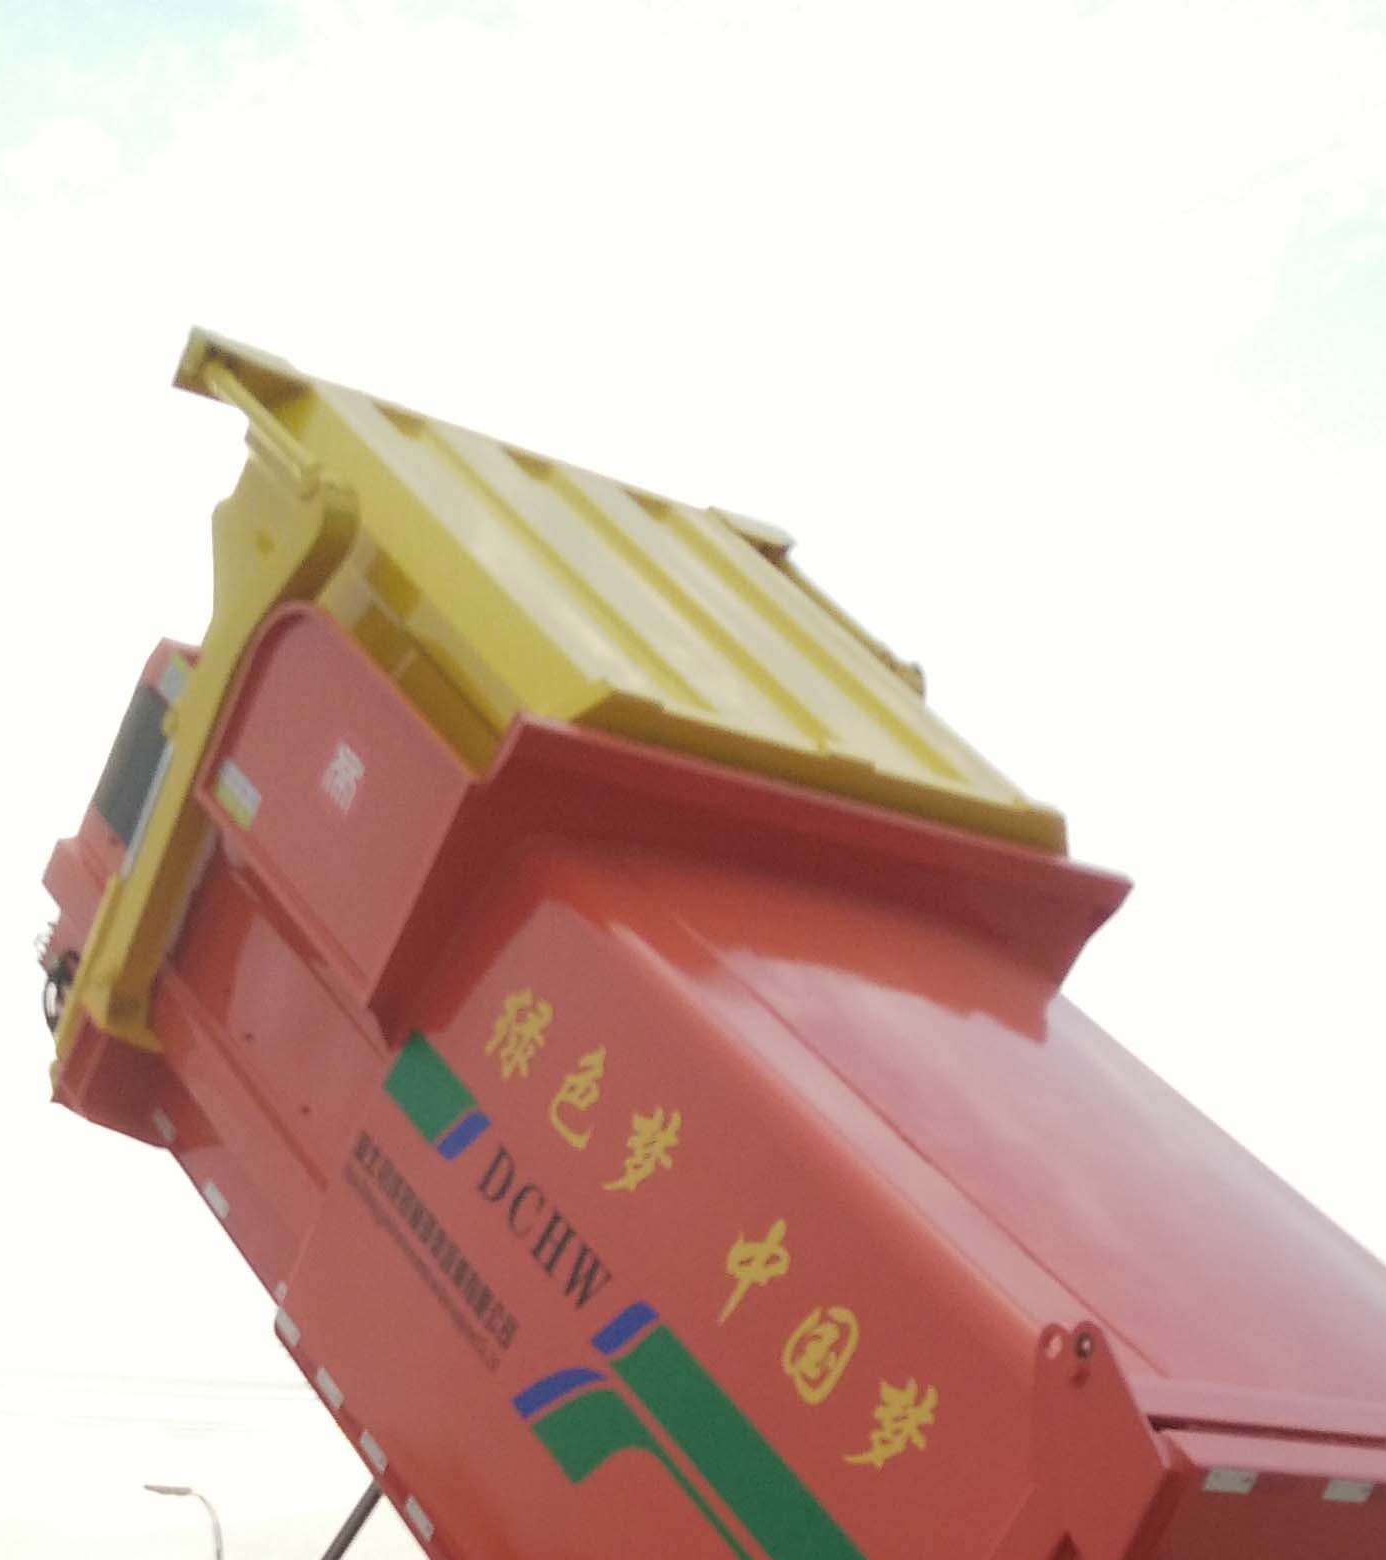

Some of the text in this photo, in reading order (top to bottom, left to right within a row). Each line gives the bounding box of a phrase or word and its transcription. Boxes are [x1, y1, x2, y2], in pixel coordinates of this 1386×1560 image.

[478, 1146, 612, 1308] DCHW
[718, 1218, 939, 1468] 中国梦
